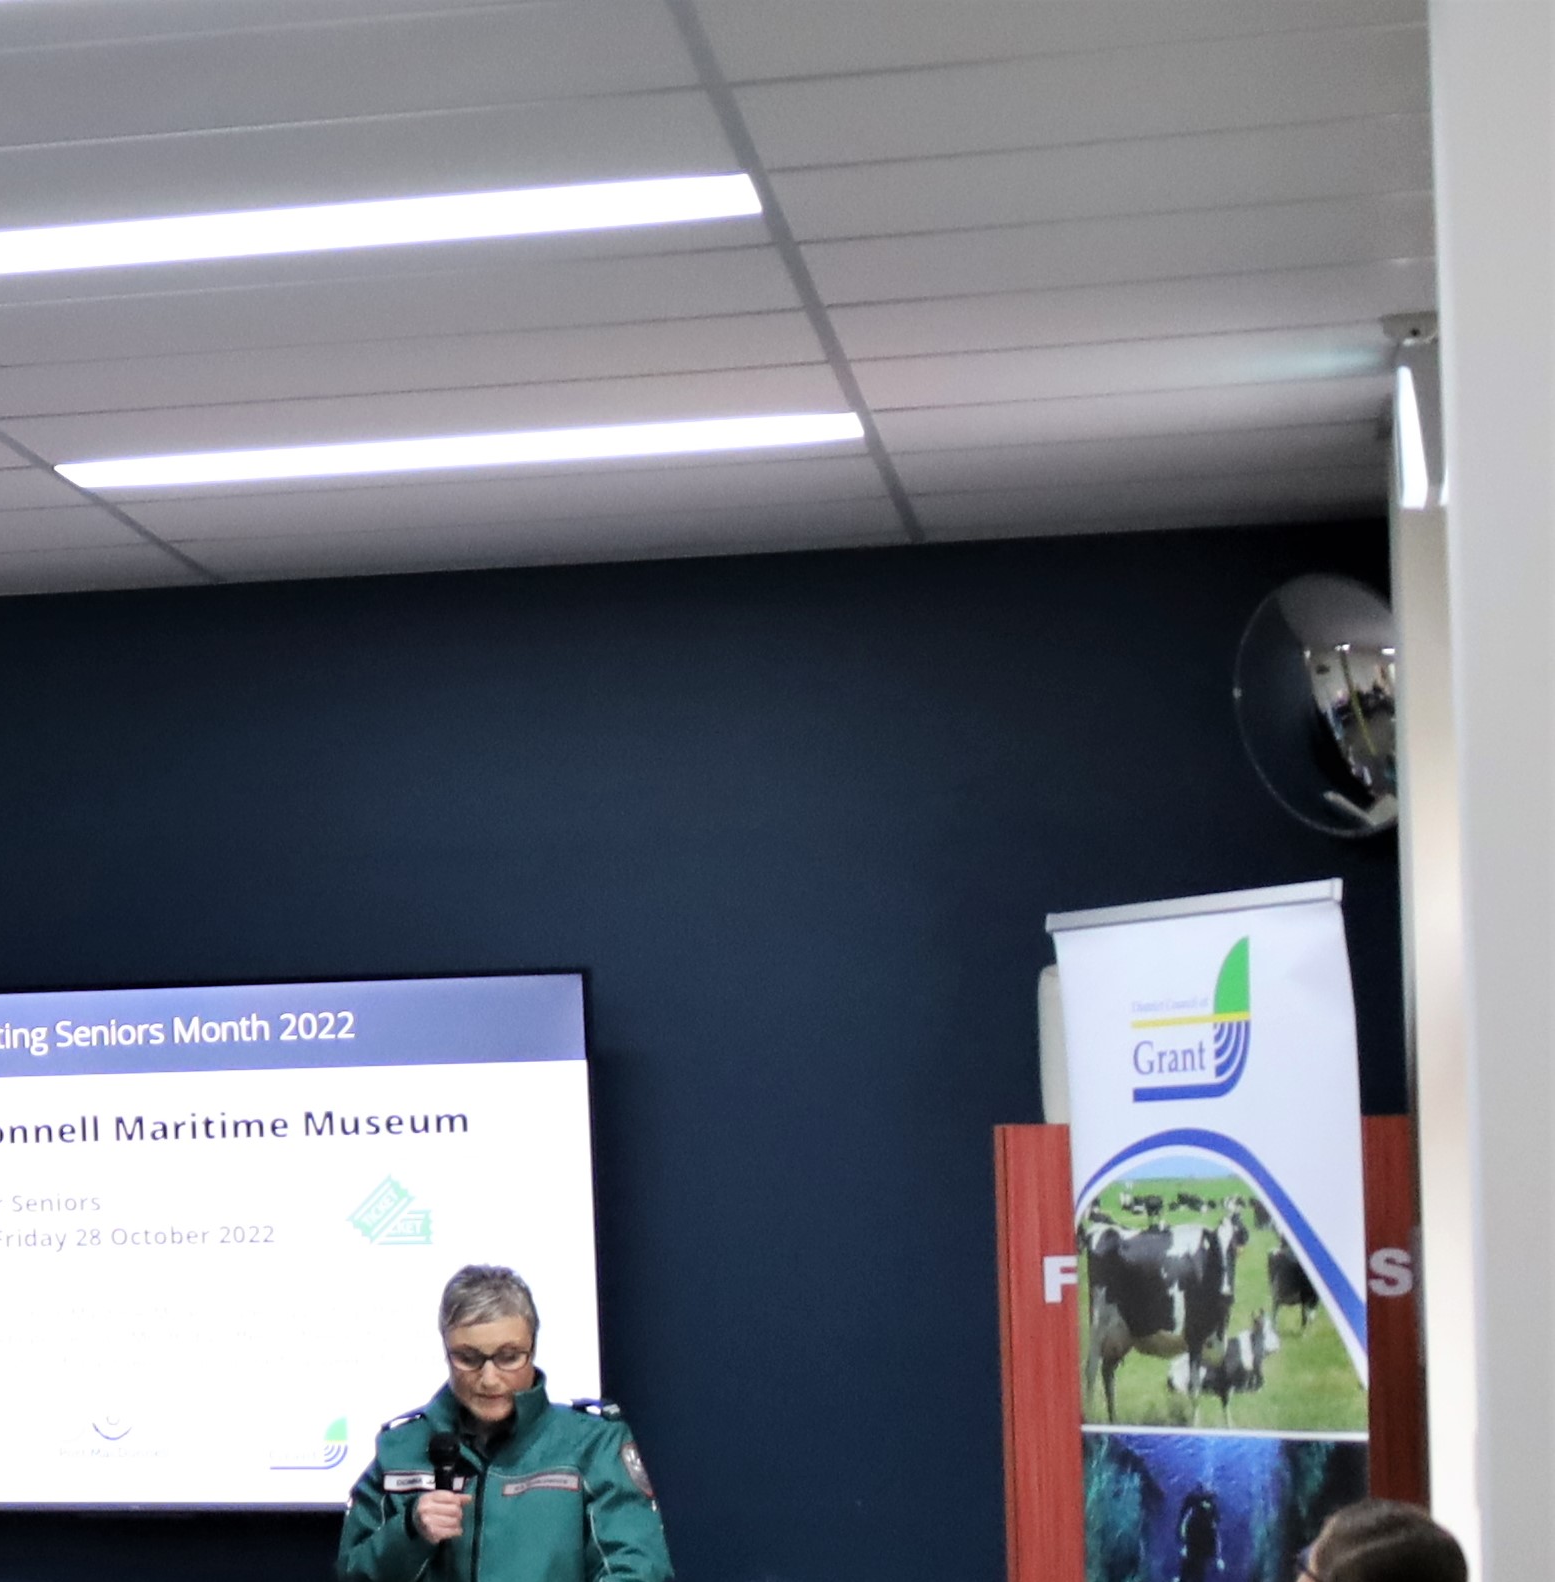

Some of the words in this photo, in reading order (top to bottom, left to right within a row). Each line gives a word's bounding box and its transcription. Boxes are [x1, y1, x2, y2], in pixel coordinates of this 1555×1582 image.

[55, 1018, 165, 1048] Seniors
[173, 1013, 270, 1044] Month
[279, 1011, 356, 1041] 2022
[1133, 1040, 1206, 1075] Grant
[115, 1112, 289, 1141] Maritime
[303, 1110, 468, 1137] Museum
[12, 1194, 101, 1212] Seniors
[76, 1228, 102, 1246] 28
[111, 1225, 210, 1246] October
[219, 1225, 275, 1244] 2022
